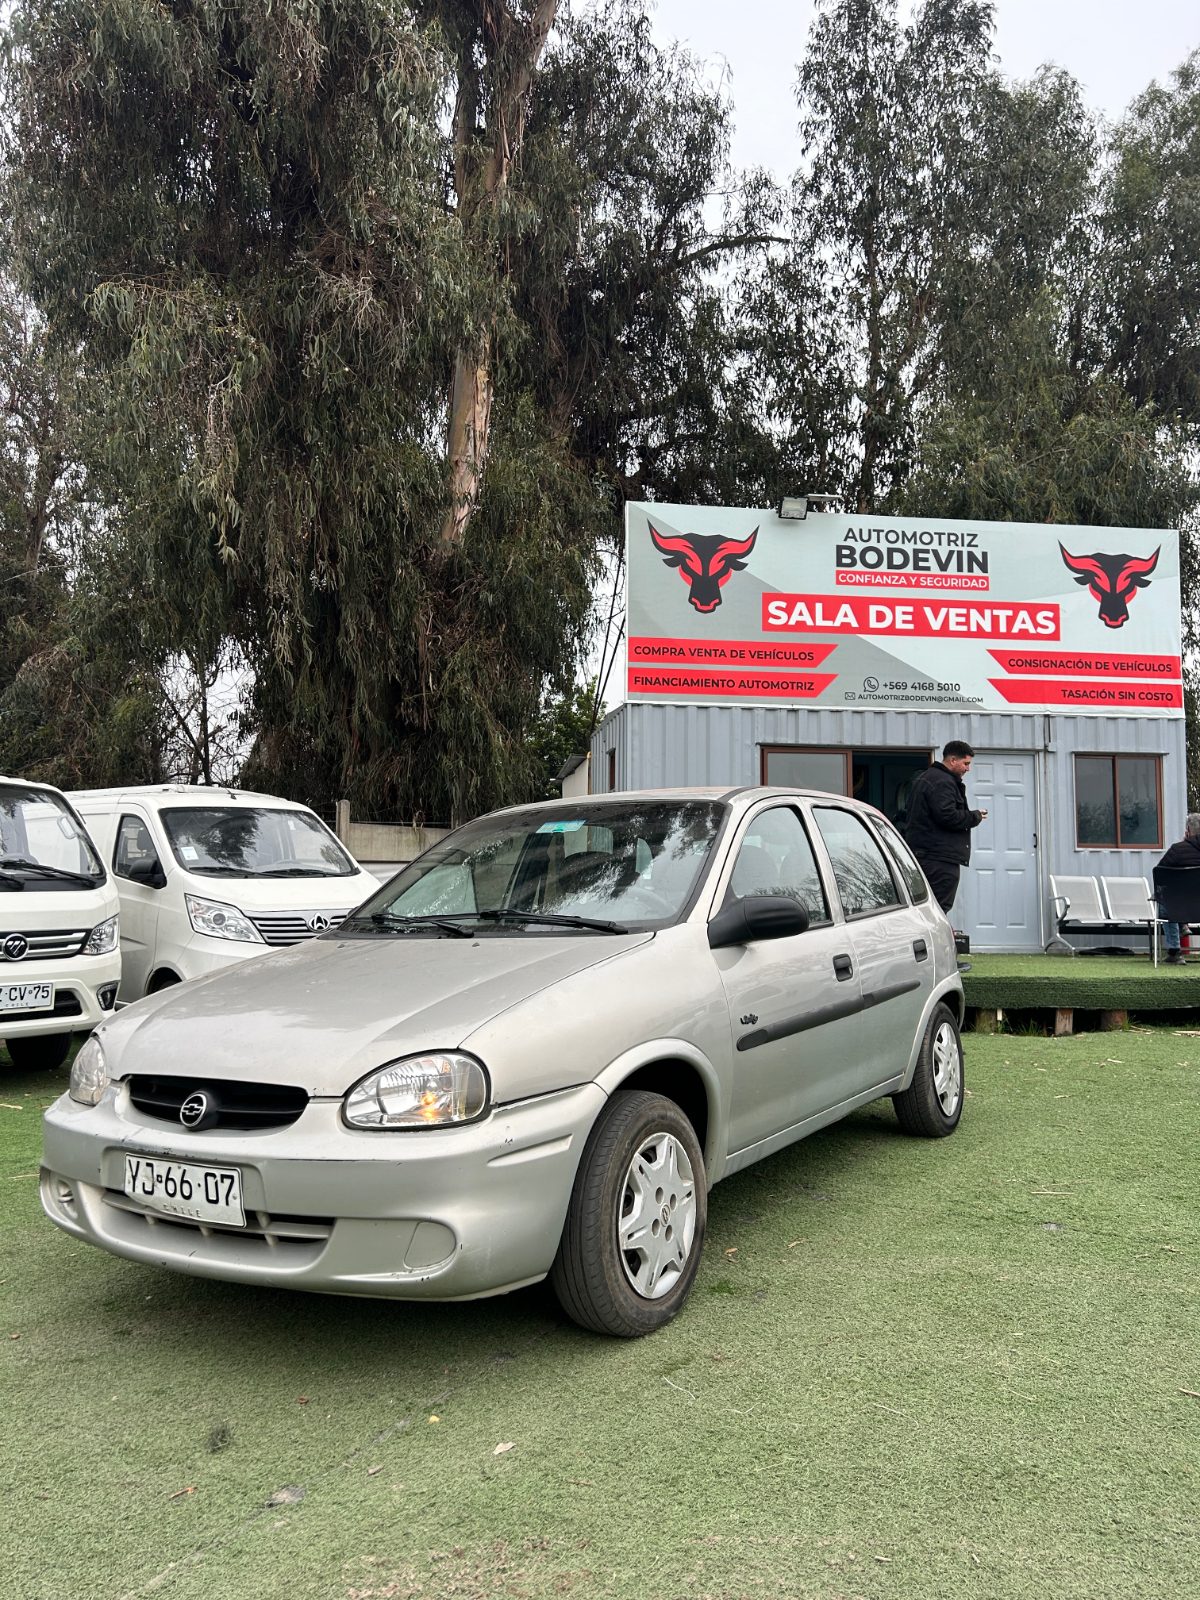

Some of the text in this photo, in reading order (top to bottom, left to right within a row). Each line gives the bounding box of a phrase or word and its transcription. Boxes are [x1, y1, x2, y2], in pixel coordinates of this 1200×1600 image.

[843, 527, 979, 548] AUTOMOTRIZ
[836, 544, 989, 574] BODEVIN
[838, 573, 988, 589] CONFIANZA Y SEGURIDAD
[767, 600, 1056, 635] SALA DE VENTAS
[634, 645, 815, 661] COMPRA VENTA DE VEHÍCULOS
[1008, 658, 1172, 673] CONSIGNACIÓN DE VEHÍCULOS
[634, 676, 815, 691] FINANCIAMIENTO AUTOMOTRIZ
[882, 681, 961, 692] +569 4168 5010
[857, 694, 984, 704] AUTOMOTRIZBODEVIN@GMAIL.COM
[1061, 689, 1174, 702] TASACIÓN SIN COSTO
[163, 1203, 202, 1218] CHILE
